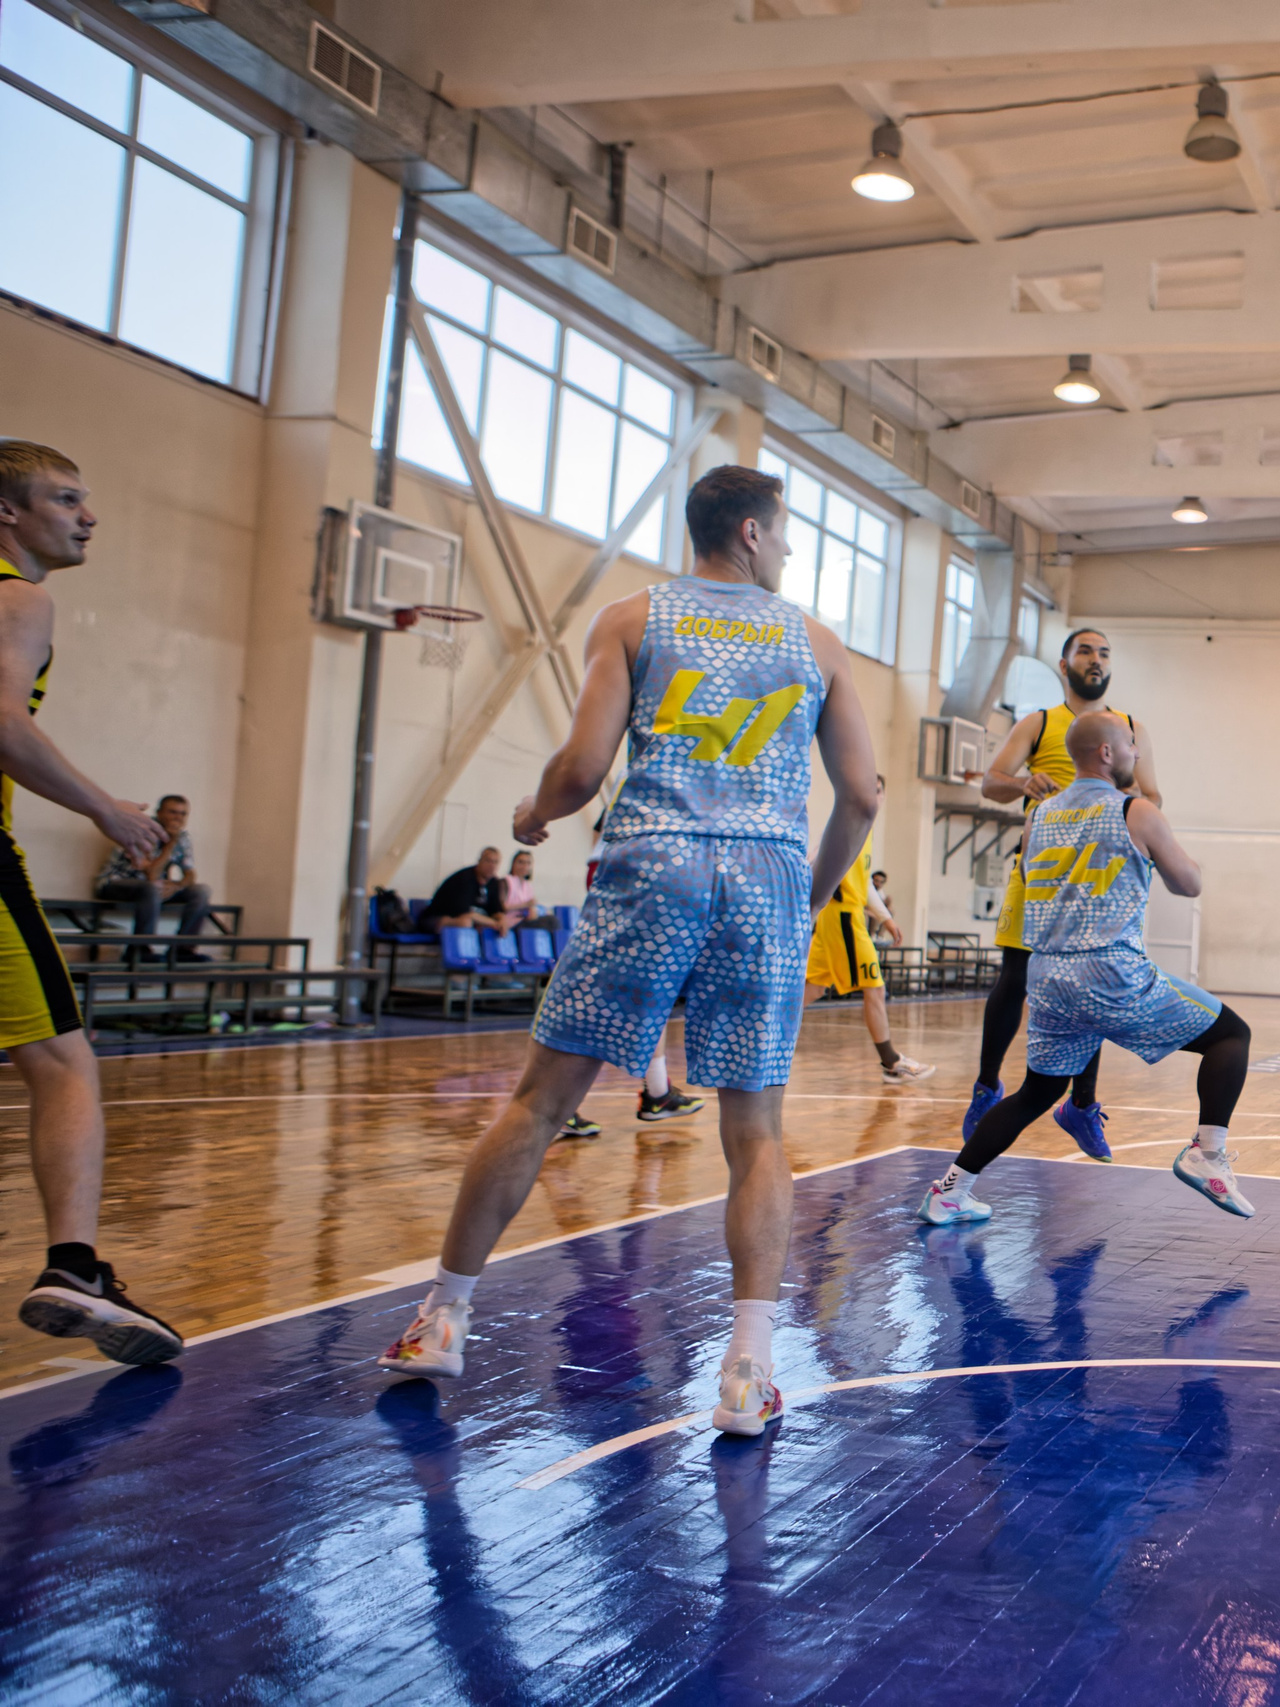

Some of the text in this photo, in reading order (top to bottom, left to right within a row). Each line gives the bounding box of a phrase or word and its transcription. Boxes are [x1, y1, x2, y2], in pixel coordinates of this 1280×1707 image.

[674, 616, 785, 645] ДОБРЫЙ
[653, 669, 807, 766] 41
[1044, 803, 1106, 825] KOROVIN
[1025, 841, 1128, 901] 24
[860, 962, 880, 980] 10
